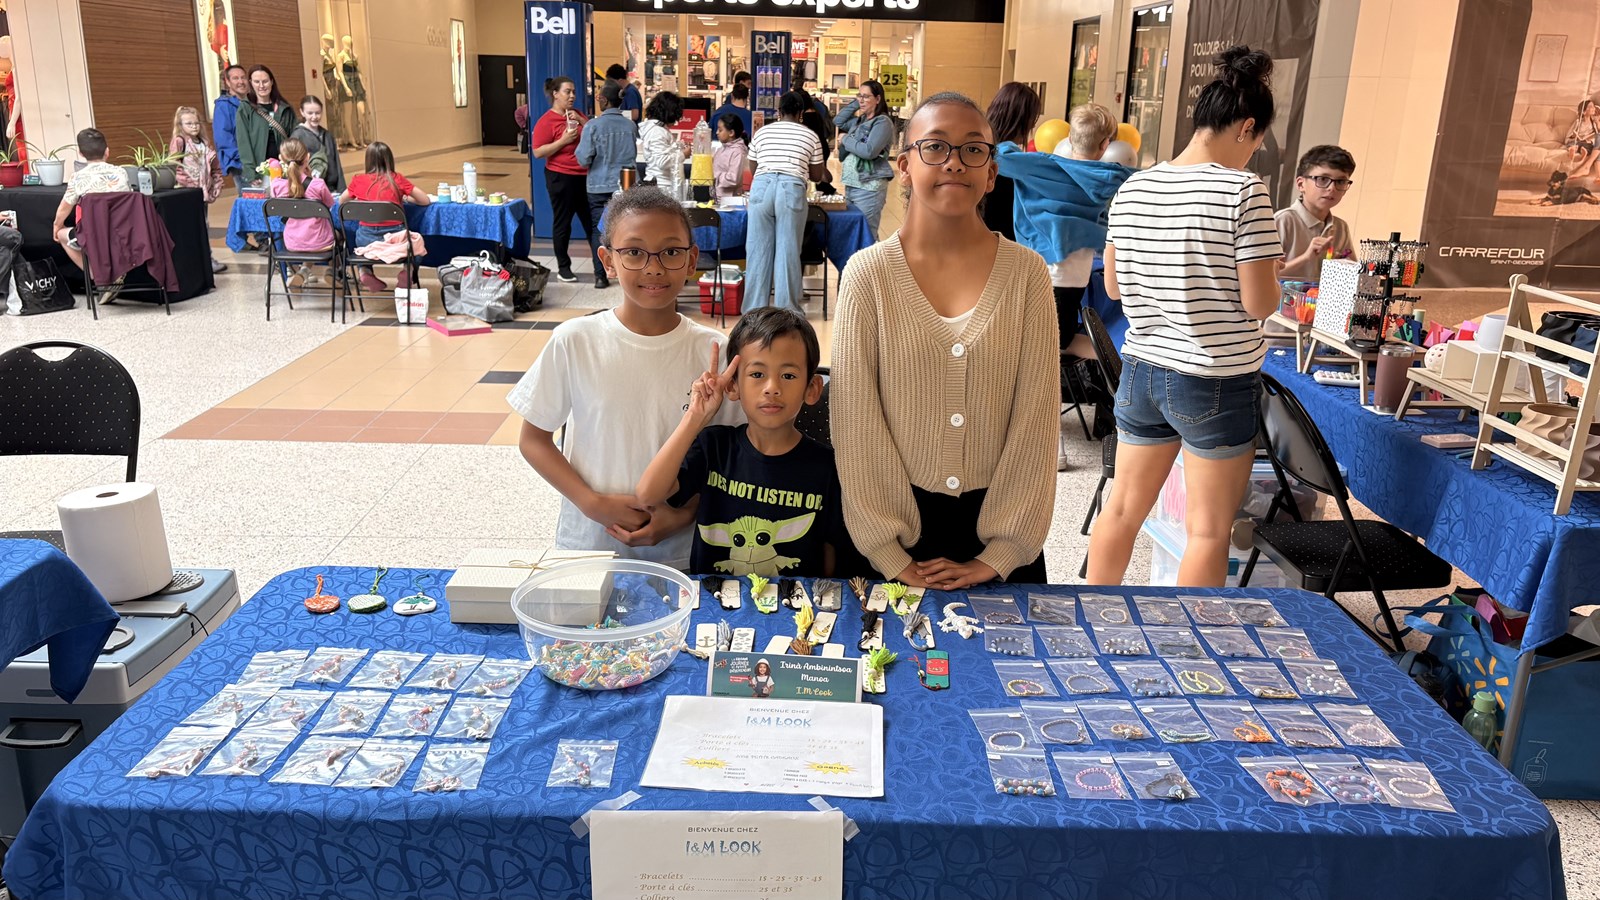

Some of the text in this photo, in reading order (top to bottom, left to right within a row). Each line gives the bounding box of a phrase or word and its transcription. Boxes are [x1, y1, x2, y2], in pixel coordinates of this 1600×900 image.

[530, 6, 576, 35] Bell
[754, 34, 786, 54] Bell
[1439, 246, 1545, 259] CARREFOUR
[24, 276, 57, 291] VICHY
[728, 480, 755, 500] NOT
[756, 486, 804, 508] LISTEN
[800, 673, 830, 683] Manoa
[746, 715, 812, 728] I&M LOOK
[686, 839, 763, 855] I&M LOOK
[639, 872, 684, 880] Bracelets
[794, 875, 803, 883] 3$
[811, 875, 823, 883] 4$
[640, 883, 667, 892] Porte
[668, 883, 675, 891] à
[678, 883, 695, 892] clés
[759, 886, 769, 894] 2$
[783, 886, 793, 894] 3$
